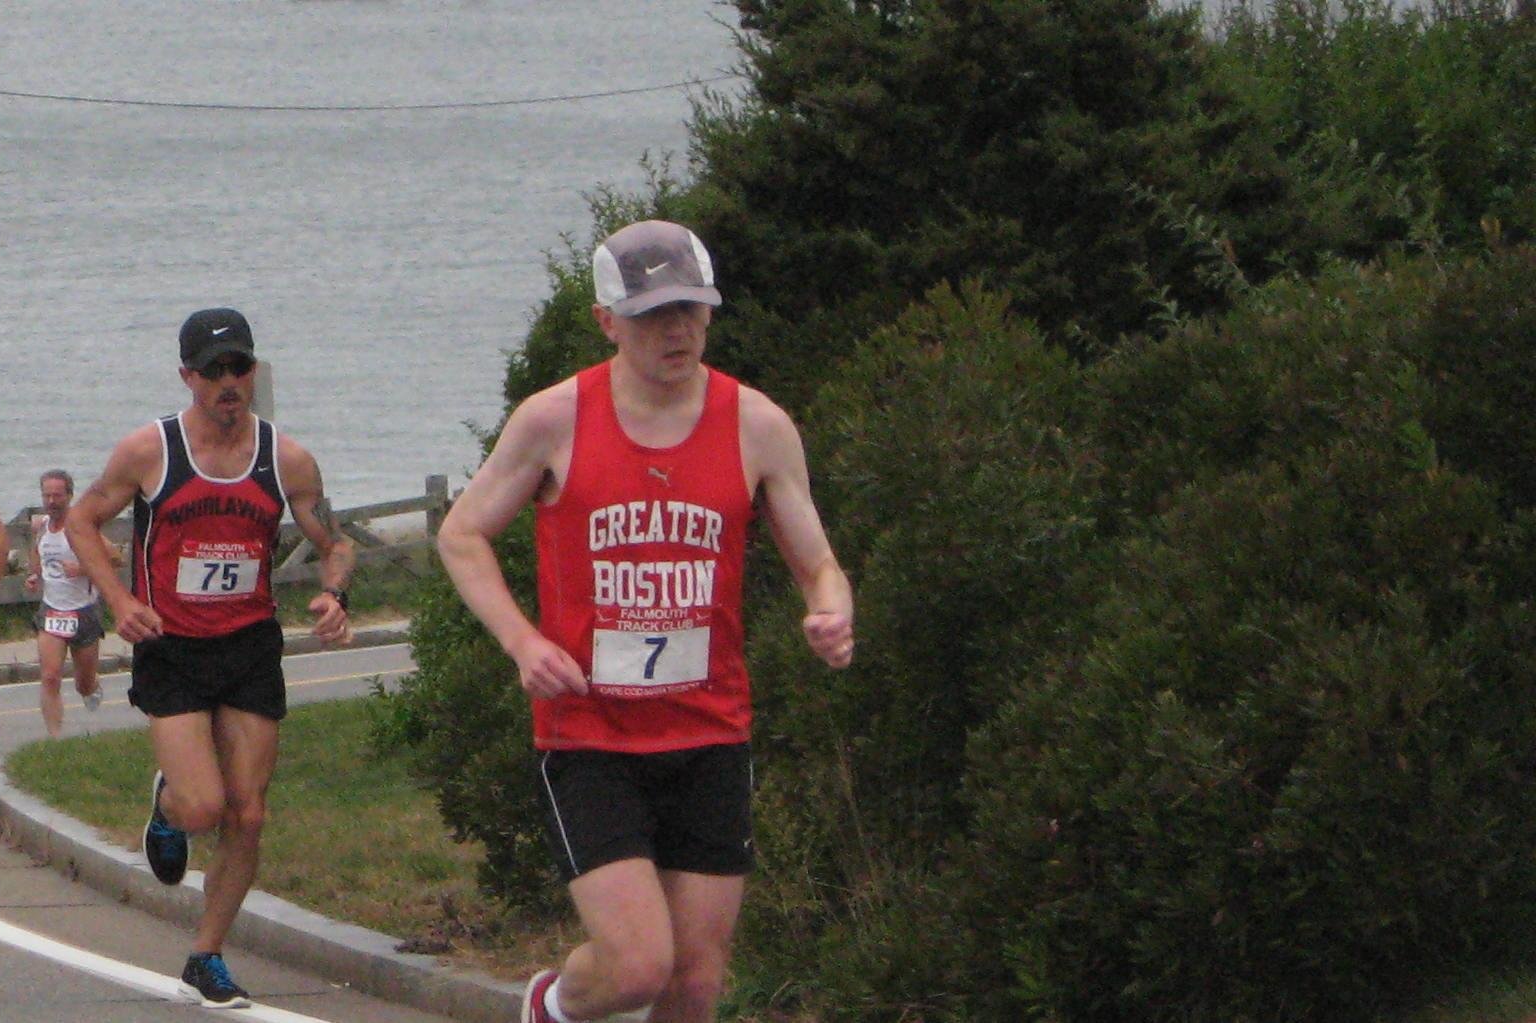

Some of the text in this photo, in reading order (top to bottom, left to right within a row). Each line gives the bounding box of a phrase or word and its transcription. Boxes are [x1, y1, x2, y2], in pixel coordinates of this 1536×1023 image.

[589, 500, 723, 553] GREATER
[198, 543, 246, 551] FALMOUTH
[225, 552, 249, 560] CLU
[201, 563, 240, 591] 75
[592, 560, 716, 608] BOSTON
[620, 609, 688, 620] FALMOUTH
[48, 619, 77, 632] 1273
[616, 619, 694, 632] TRACK CLUB
[644, 637, 668, 679] 7
